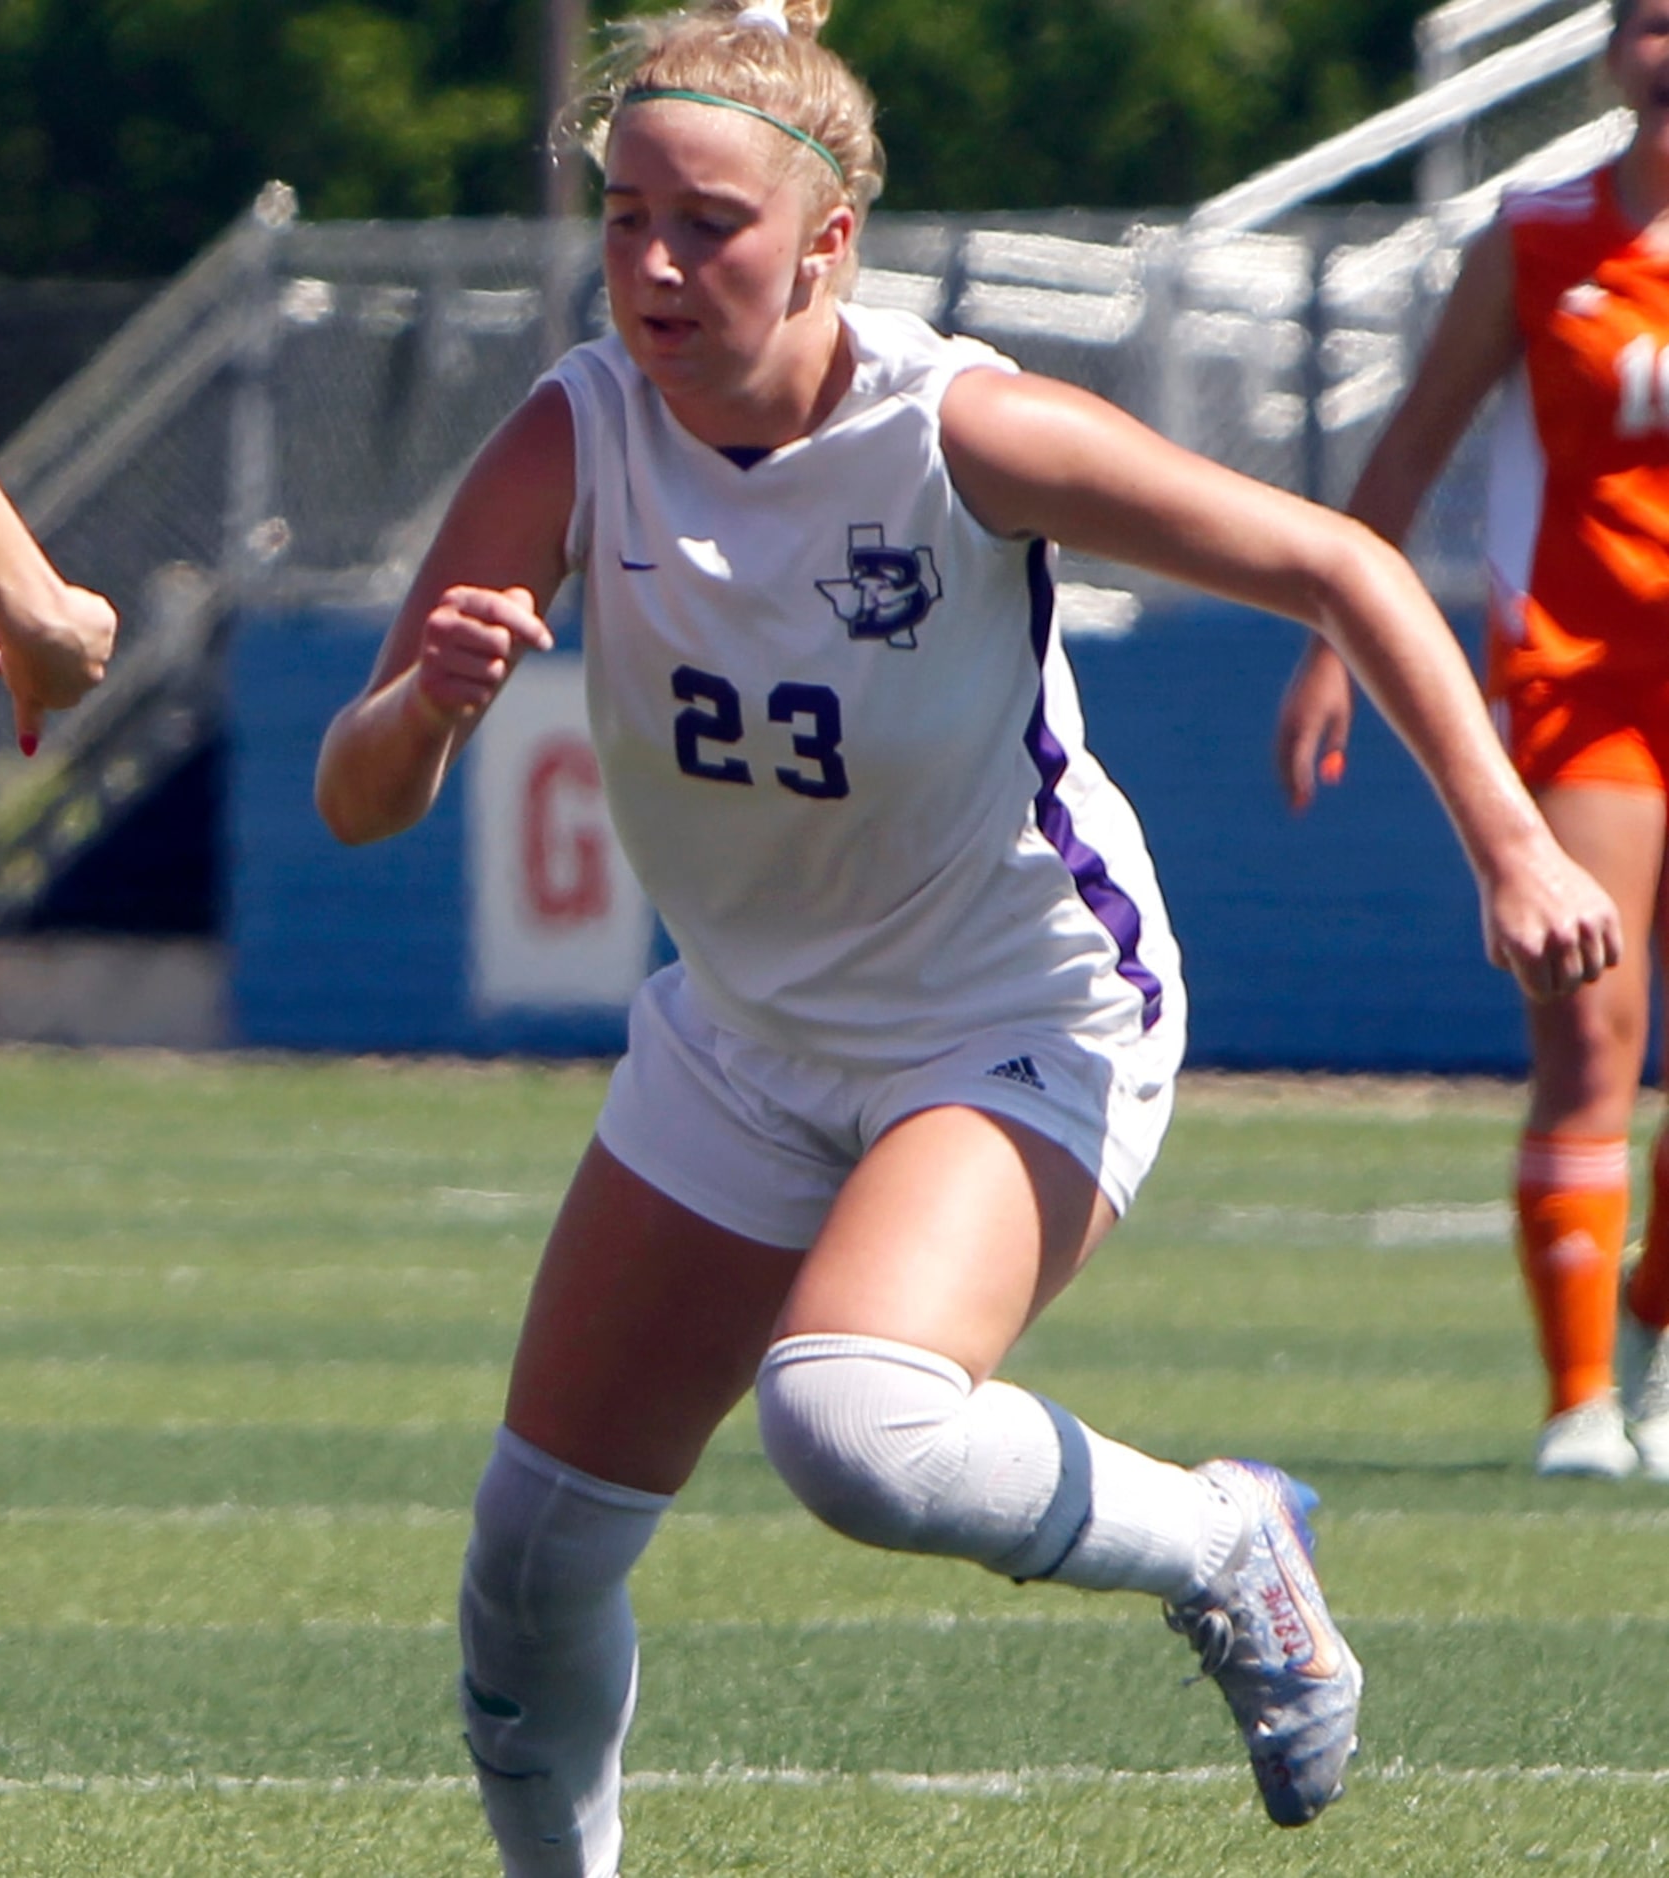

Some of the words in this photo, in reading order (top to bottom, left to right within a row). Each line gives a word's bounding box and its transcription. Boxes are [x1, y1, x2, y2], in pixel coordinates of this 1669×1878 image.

[1615, 331, 1669, 438] 1
[671, 664, 850, 800] 23
[520, 734, 612, 927] G
